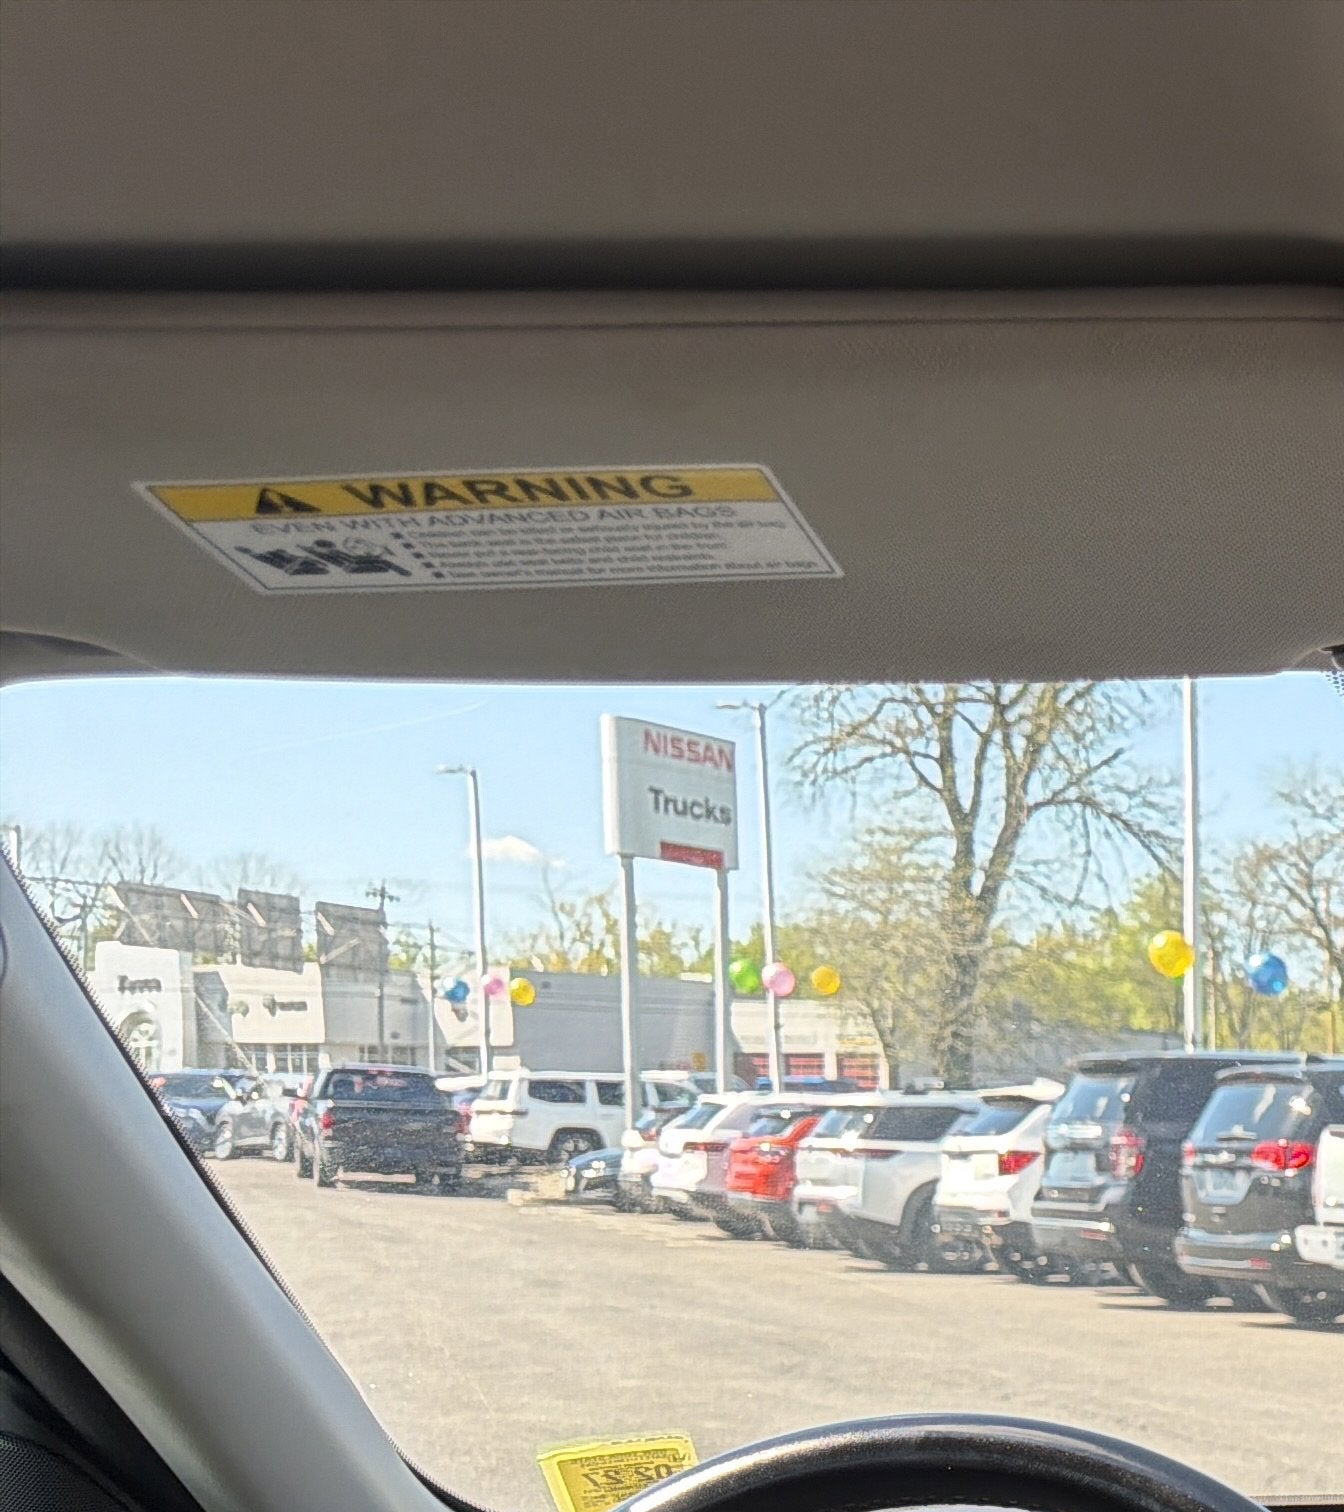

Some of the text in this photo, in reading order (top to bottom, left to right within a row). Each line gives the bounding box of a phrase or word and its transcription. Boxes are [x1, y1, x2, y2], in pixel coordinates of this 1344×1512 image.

[341, 475, 693, 508] WARNING
[252, 519, 335, 534] EVEN
[340, 515, 421, 530] WITH
[429, 510, 590, 527] ADVANCED
[597, 507, 648, 520] AIR
[652, 506, 738, 520] BAGS
[643, 728, 733, 773] NISSAN
[648, 785, 732, 825] Trucks
